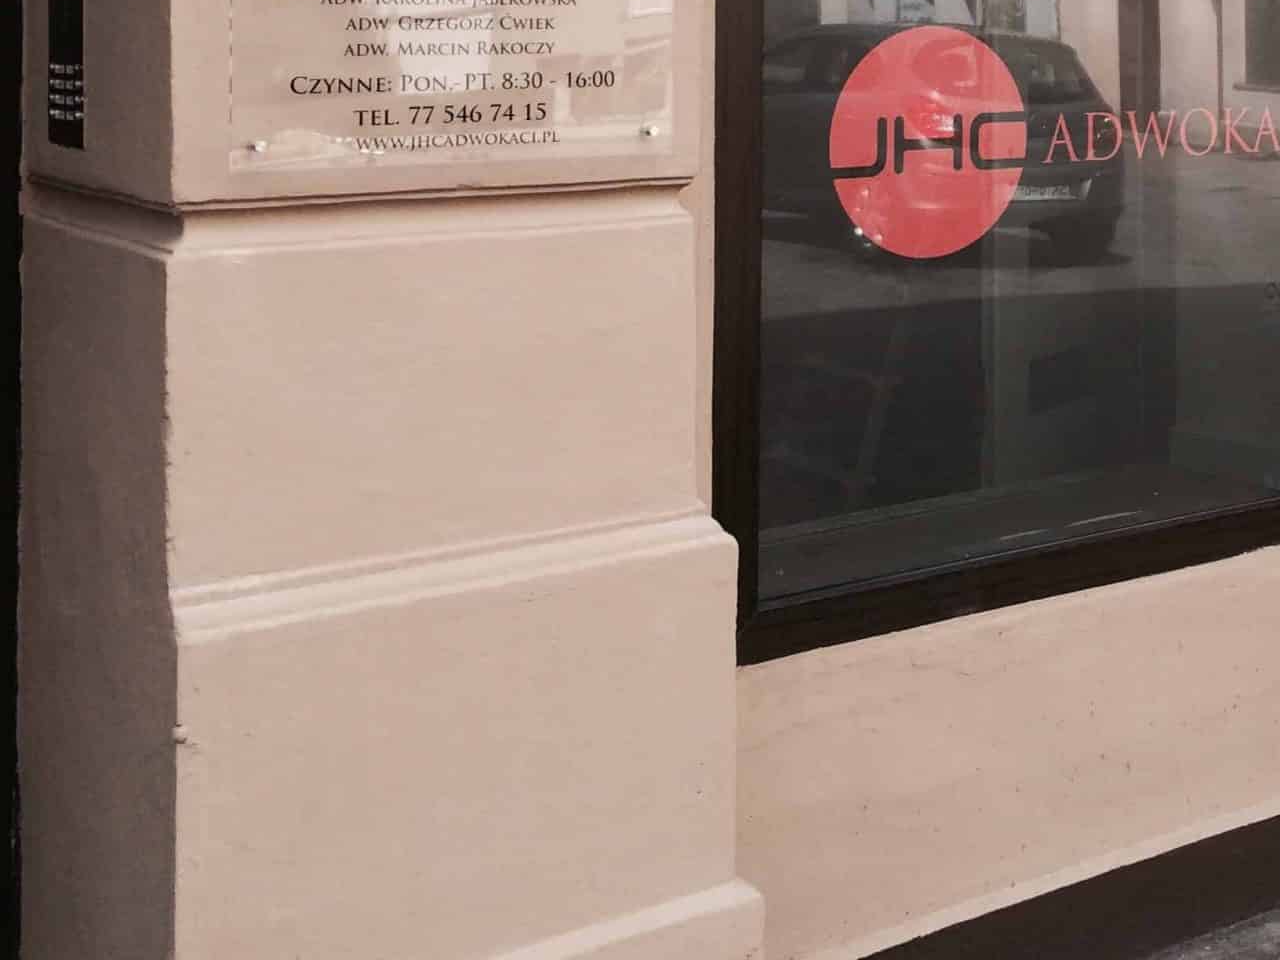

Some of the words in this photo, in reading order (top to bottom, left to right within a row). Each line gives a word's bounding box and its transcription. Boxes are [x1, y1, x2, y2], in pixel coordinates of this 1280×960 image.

[398, 16, 494, 31] GRZEGORZ
[344, 43, 389, 57] ADW.
[400, 42, 470, 56] MARCIN
[477, 41, 555, 55] RAKOCZY
[290, 76, 392, 95] CZYNNE:
[501, 71, 543, 89] 8:30
[566, 70, 615, 88] 16:00
[353, 109, 400, 126] TEL.
[408, 105, 435, 125] 77
[443, 104, 482, 124] 546
[490, 103, 515, 122] 74
[523, 102, 547, 121] 15
[356, 131, 561, 151] WWW.JHCADWOKACI.PL
[830, 111, 1027, 179] JHC
